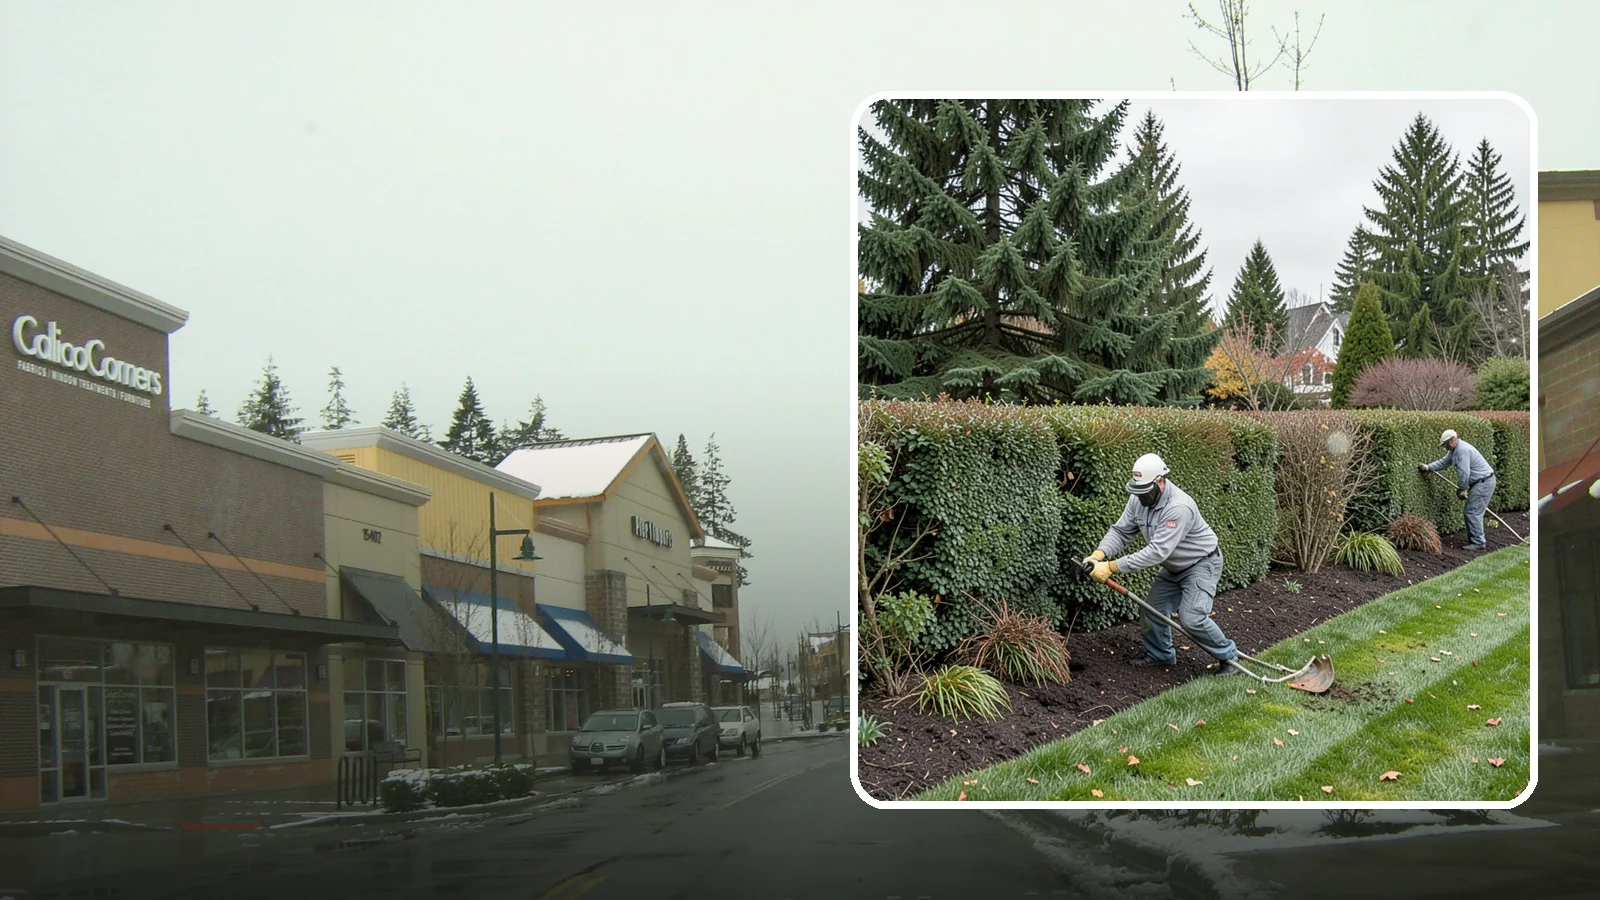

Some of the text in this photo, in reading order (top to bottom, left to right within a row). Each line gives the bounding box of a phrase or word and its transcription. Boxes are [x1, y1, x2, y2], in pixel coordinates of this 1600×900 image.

[17, 360, 47, 378] FABRICS
[51, 370, 78, 386] WINDOW
[78, 378, 117, 397] TREATMENTS
[120, 391, 151, 408] FURNITURE
